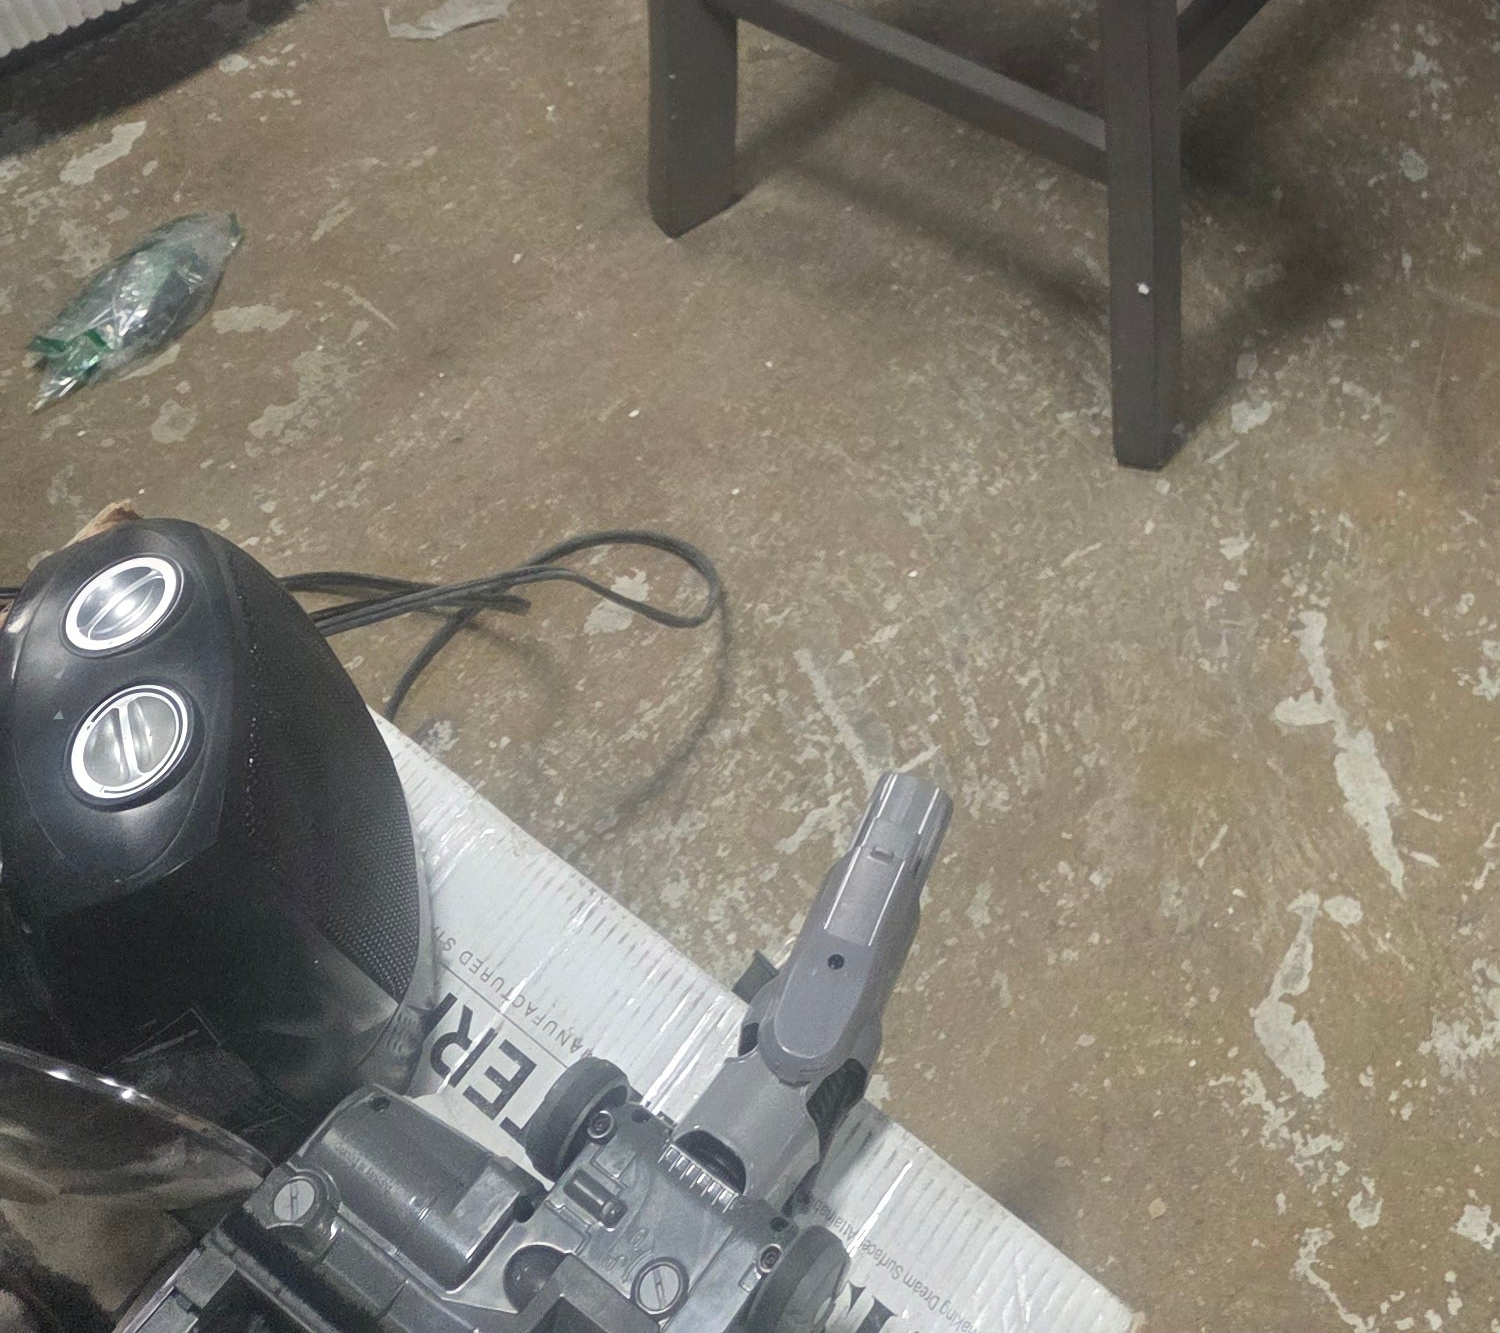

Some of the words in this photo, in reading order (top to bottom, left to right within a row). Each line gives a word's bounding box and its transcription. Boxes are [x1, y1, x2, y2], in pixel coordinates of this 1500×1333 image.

[433, 925, 457, 953] ST
[804, 1195, 859, 1242] Attainab
[898, 1271, 943, 1310] Dream
